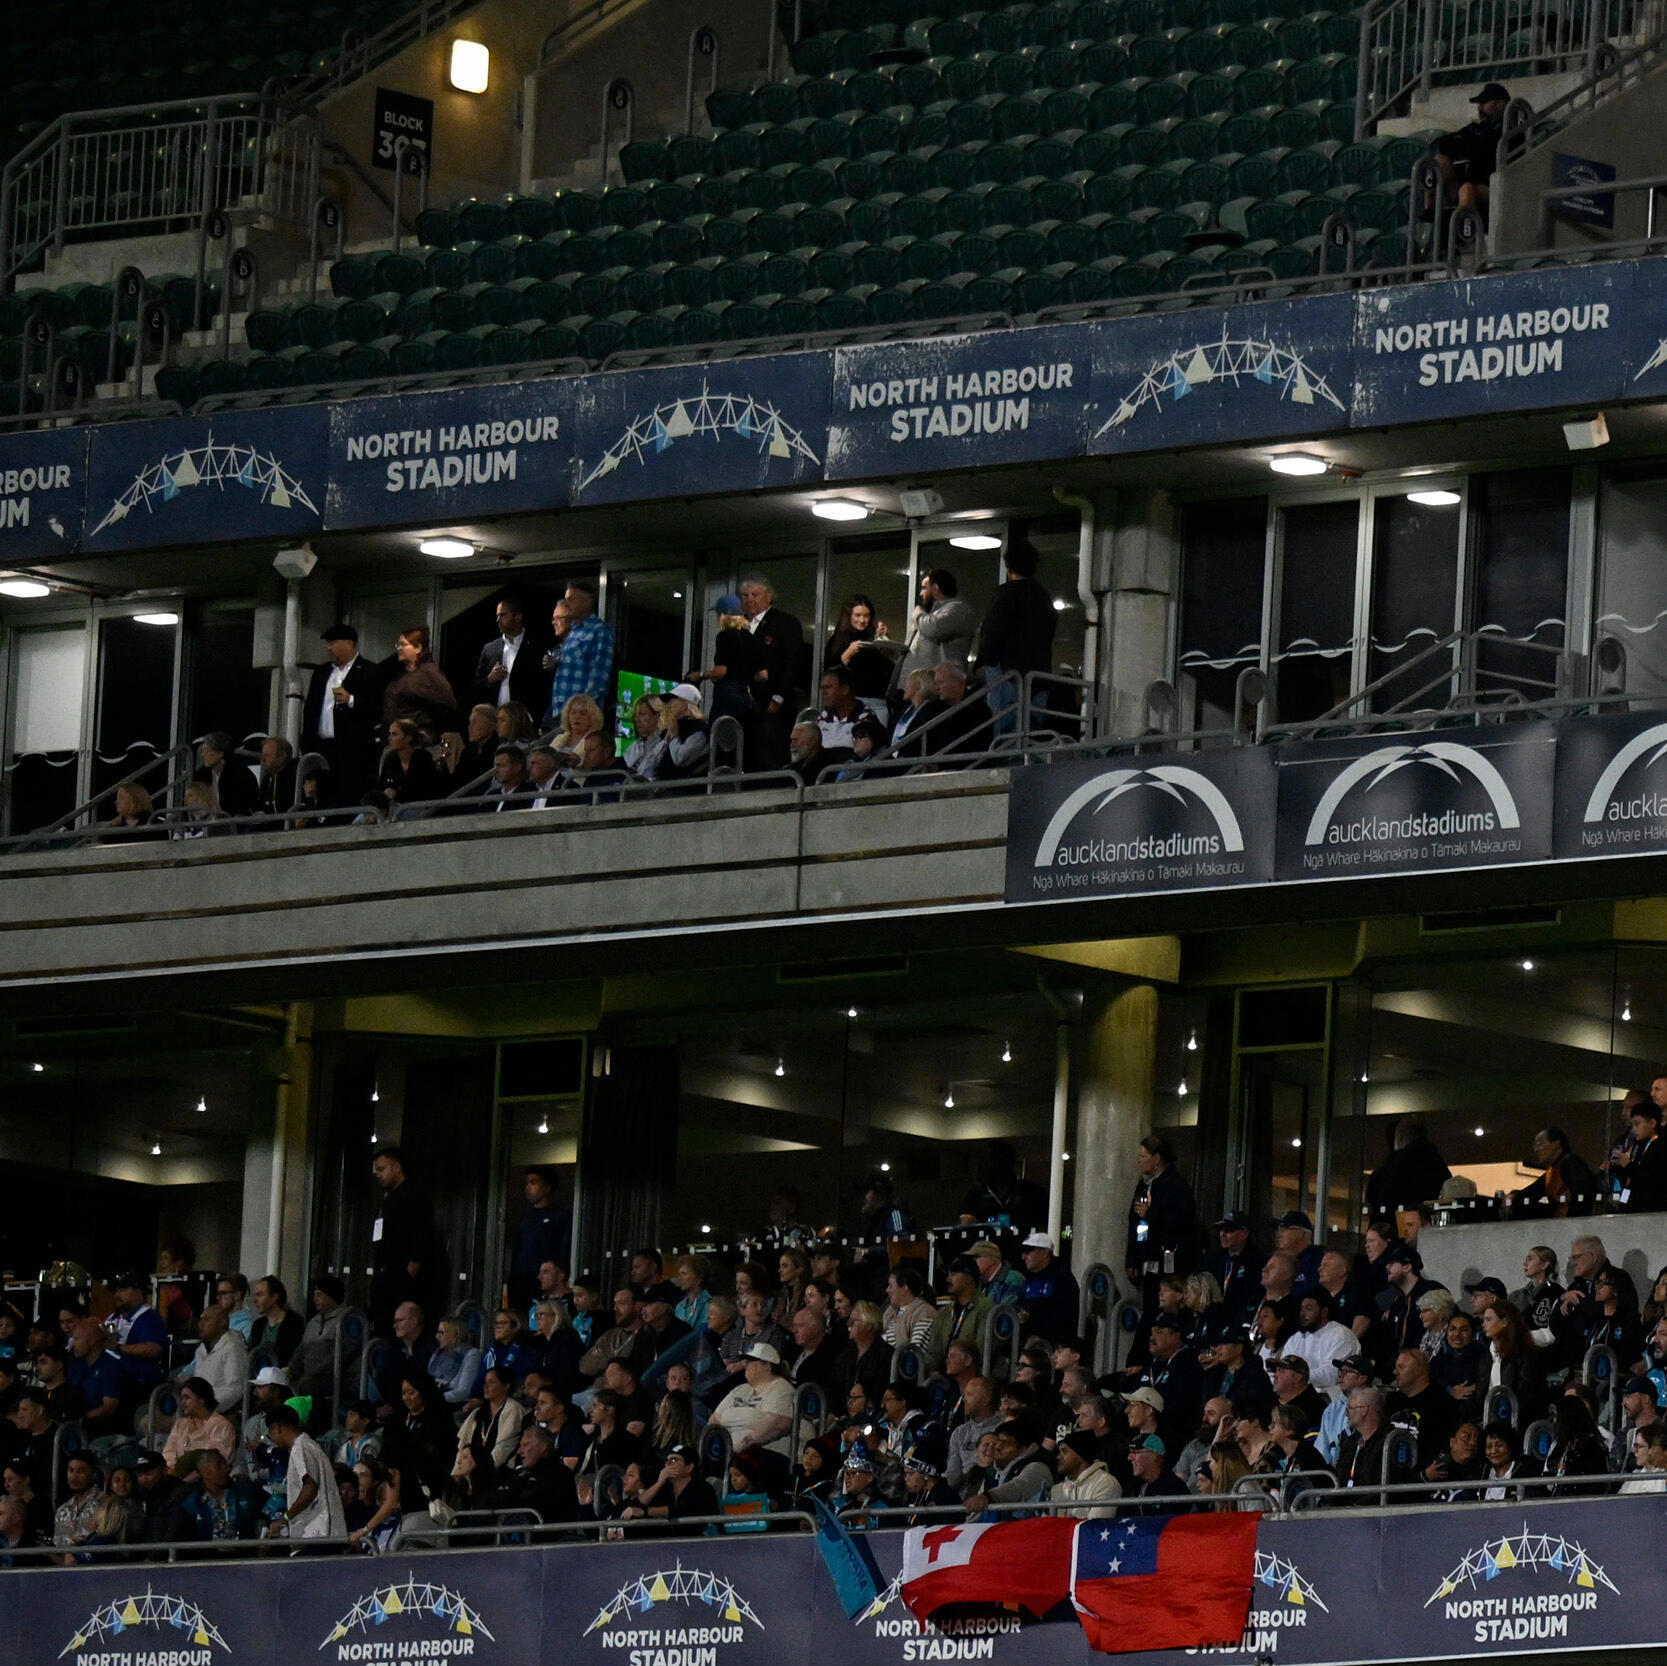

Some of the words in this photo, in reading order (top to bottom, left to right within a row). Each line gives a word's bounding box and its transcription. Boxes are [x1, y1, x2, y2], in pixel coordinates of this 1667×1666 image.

[384, 110, 425, 132] BLOCK
[1376, 318, 1468, 353] NORTH
[1477, 304, 1609, 342] HARBOUR
[1419, 340, 1562, 386] STADIUM
[850, 376, 938, 411] NORTH
[946, 363, 1073, 400] HARBOUR
[891, 398, 1029, 442] STADIUM
[347, 429, 431, 460] NORTH
[440, 416, 559, 451] HARBOUR
[386, 450, 516, 491] STADIUM
[1329, 810, 1494, 844] aucklandstadiums
[1058, 833, 1219, 866] aucklandstadiums
[1056, 874, 1088, 887] Whare
[1196, 862, 1244, 876] Makaurau
[1446, 1599, 1507, 1619] NORTH
[1512, 1592, 1597, 1614] HARBOUR
[603, 1630, 660, 1648] NORTH
[665, 1627, 743, 1645] HARBOUR
[940, 1615, 1021, 1636] HARBOUR
[1475, 1615, 1567, 1642] STADIUM
[338, 1643, 393, 1660] NORTH
[398, 1639, 474, 1658] HARBOUR
[903, 1638, 993, 1661] STADIUM
